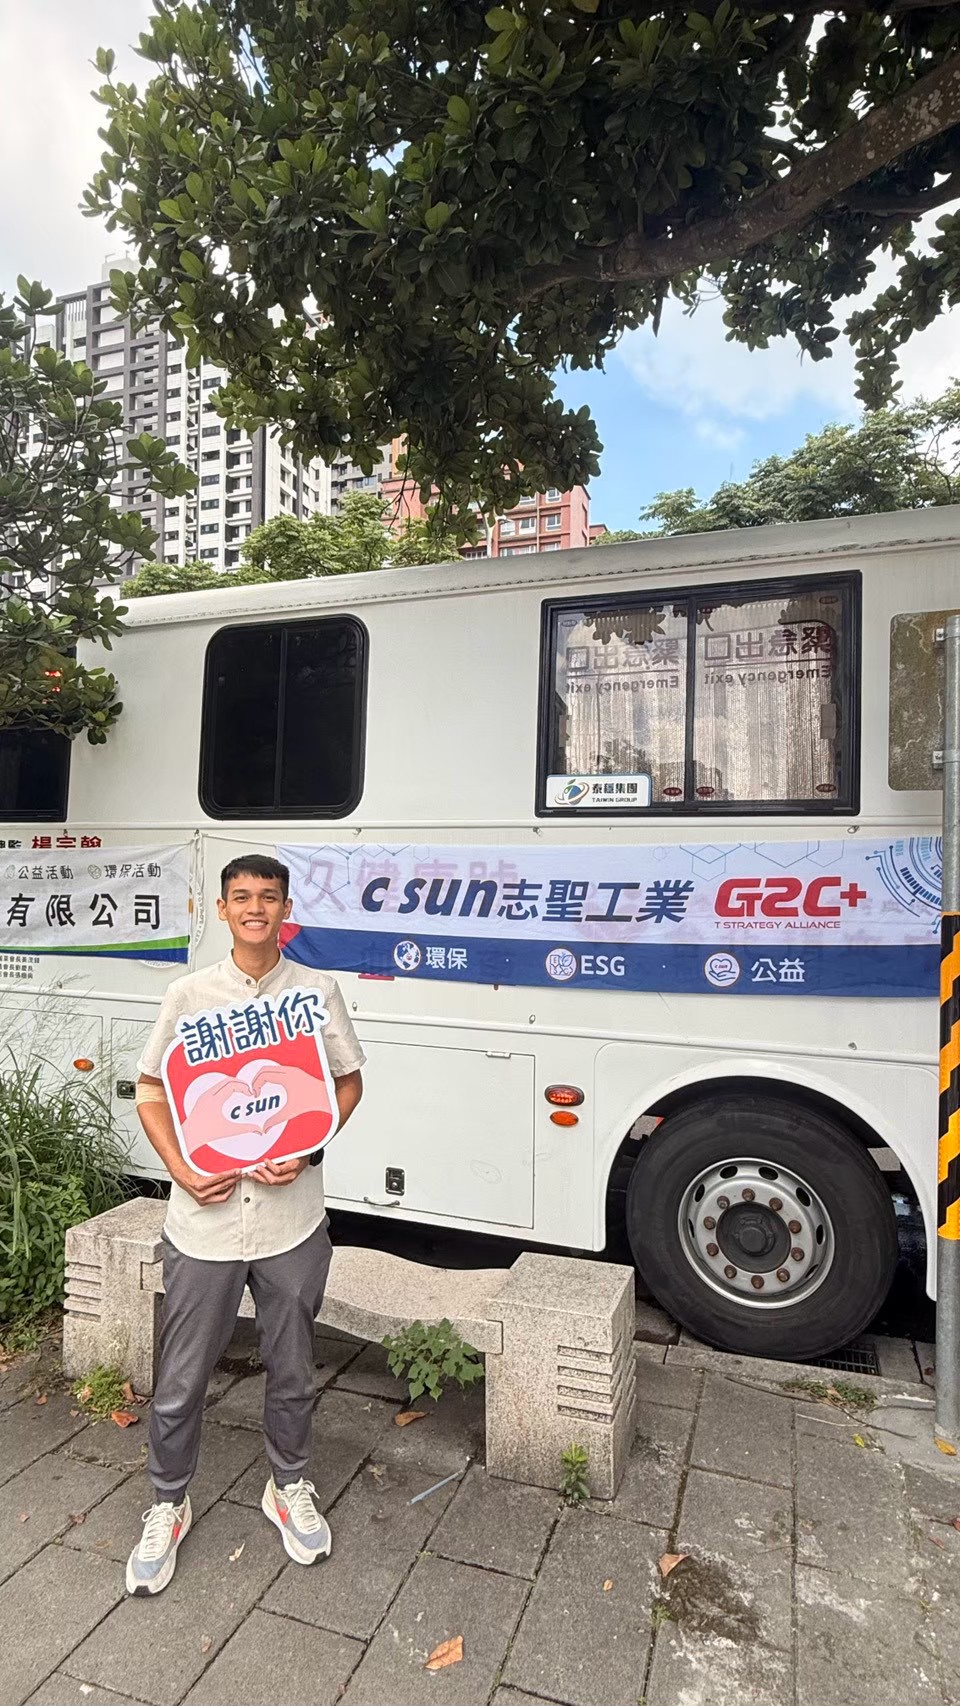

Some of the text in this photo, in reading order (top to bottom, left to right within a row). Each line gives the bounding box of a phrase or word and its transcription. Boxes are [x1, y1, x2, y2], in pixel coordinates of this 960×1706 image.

[18, 863, 161, 880] 公益活動 環保活動
[6, 893, 160, 930] 有限公司
[497, 879, 694, 923] 志聖工業
[723, 921, 782, 929] STRATEGY
[785, 921, 841, 929] ALLIANCE
[426, 947, 467, 970] 環保
[581, 955, 625, 976] ESG
[751, 958, 805, 982] 公益
[181, 992, 325, 1063] 謝謝你
[230, 1095, 280, 1119] c sun
